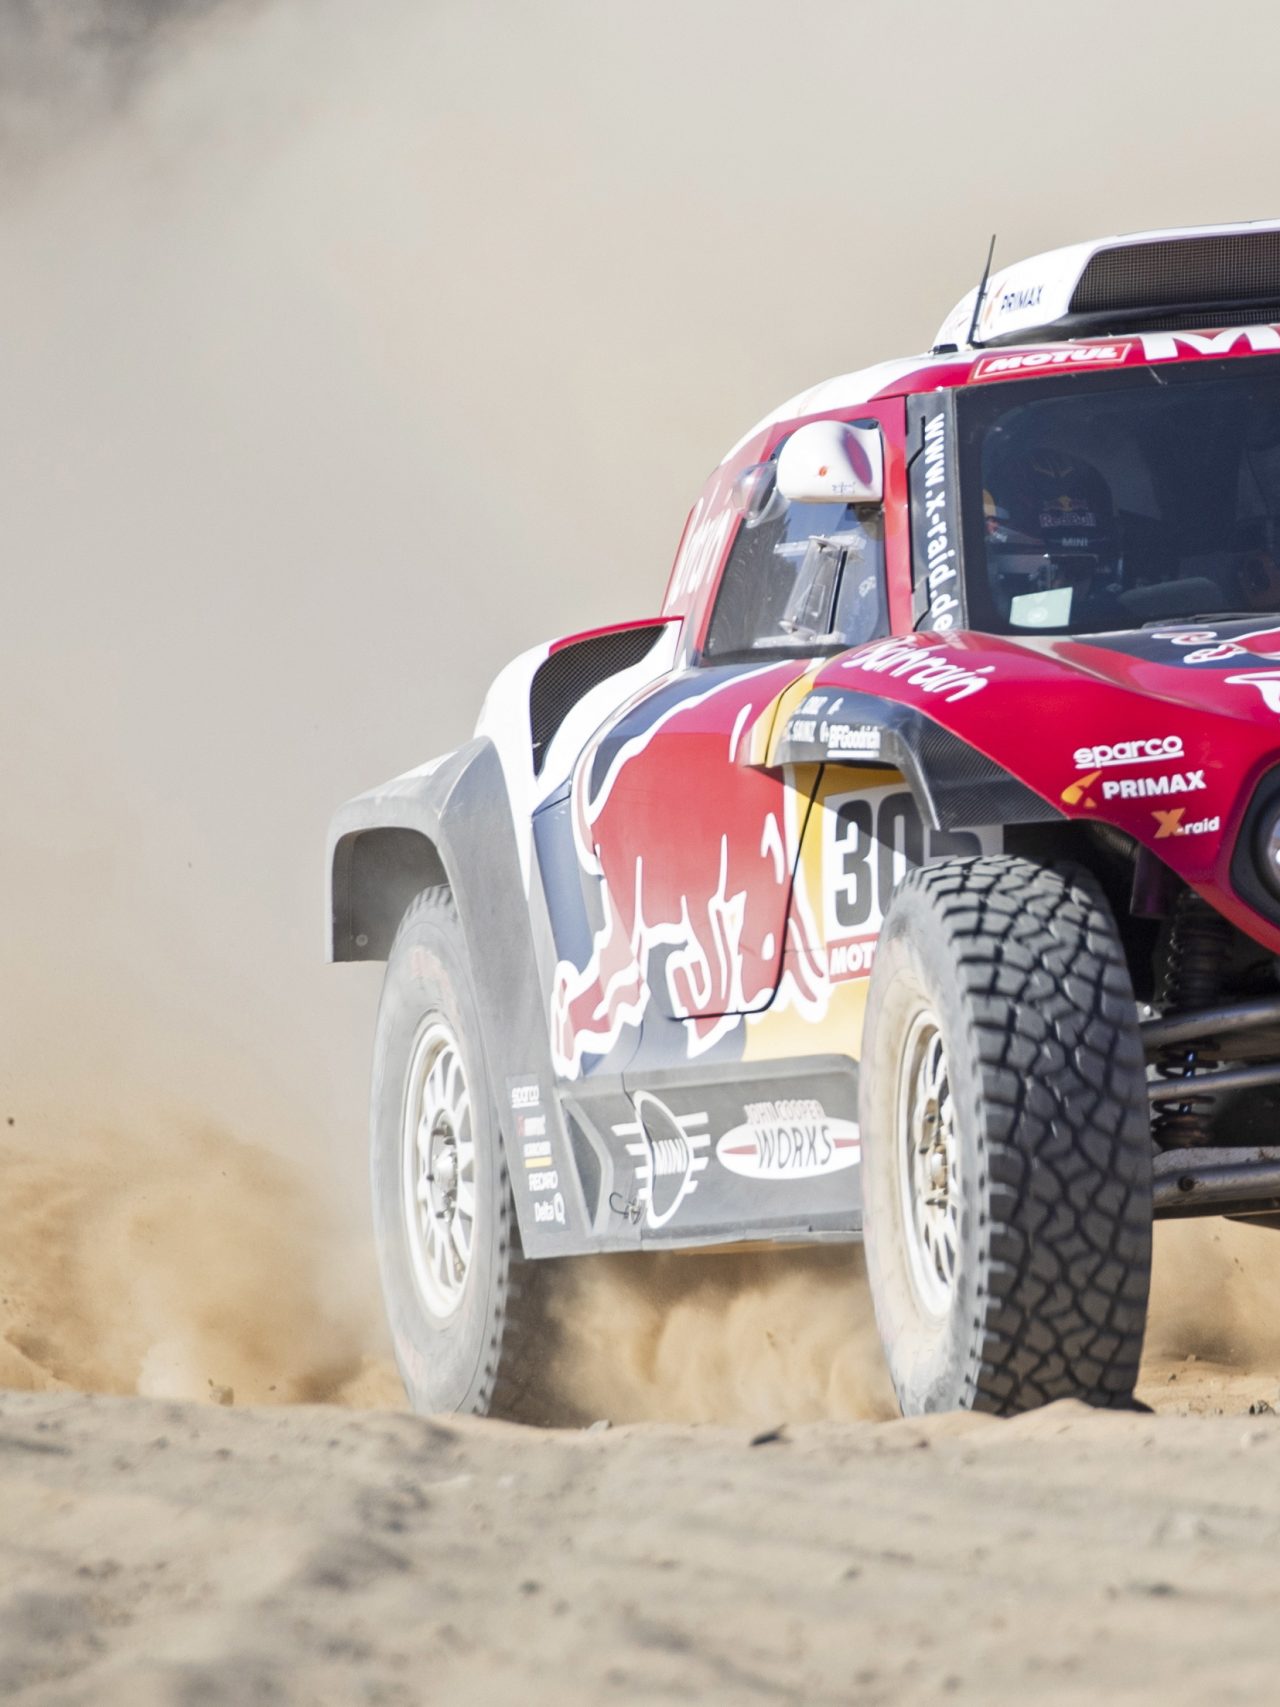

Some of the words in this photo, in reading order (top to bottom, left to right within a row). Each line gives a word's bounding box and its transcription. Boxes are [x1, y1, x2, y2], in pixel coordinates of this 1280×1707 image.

[984, 344, 1118, 374] MOTUL
[924, 412, 958, 631] www.x-raid.de
[1073, 735, 1184, 768] sparco
[1102, 769, 1207, 799] PRIMAX
[1151, 807, 1220, 839] X-raid
[652, 1139, 688, 1175] MINI
[755, 1124, 833, 1169] WORKS
